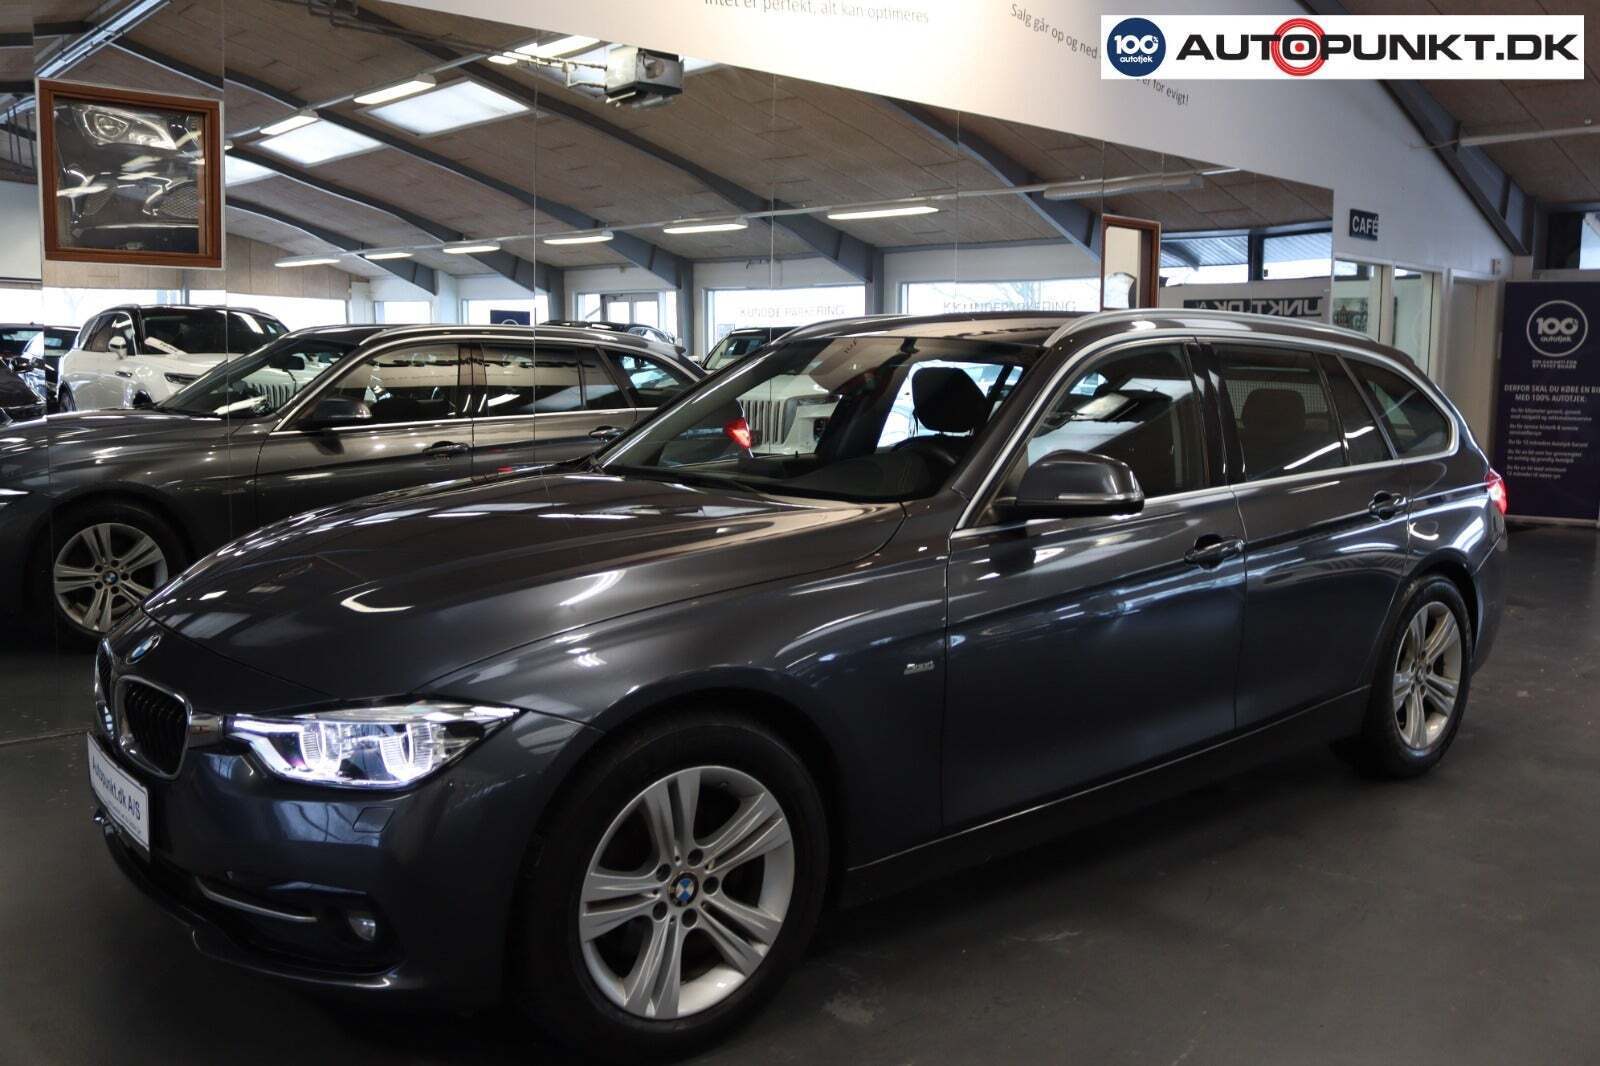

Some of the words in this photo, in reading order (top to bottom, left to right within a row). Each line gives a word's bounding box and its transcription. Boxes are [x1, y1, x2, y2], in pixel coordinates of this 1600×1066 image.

[820, 3, 837, 16] alt
[842, 4, 864, 18] kan
[867, 8, 929, 23] optimeres
[1011, 4, 1031, 27] Salg
[1033, 17, 1048, 32] går
[1051, 27, 1064, 42] op
[1066, 36, 1078, 51] og
[1080, 41, 1098, 59] ned
[1166, 86, 1189, 105] evigt!
[1352, 214, 1379, 235] CAFÉ
[1504, 384, 1529, 393] DERFOR
[1531, 385, 1547, 393] SKAL
[1549, 385, 1560, 393] DU
[1515, 393, 1530, 401] MED
[128, 795, 140, 820] A/S
